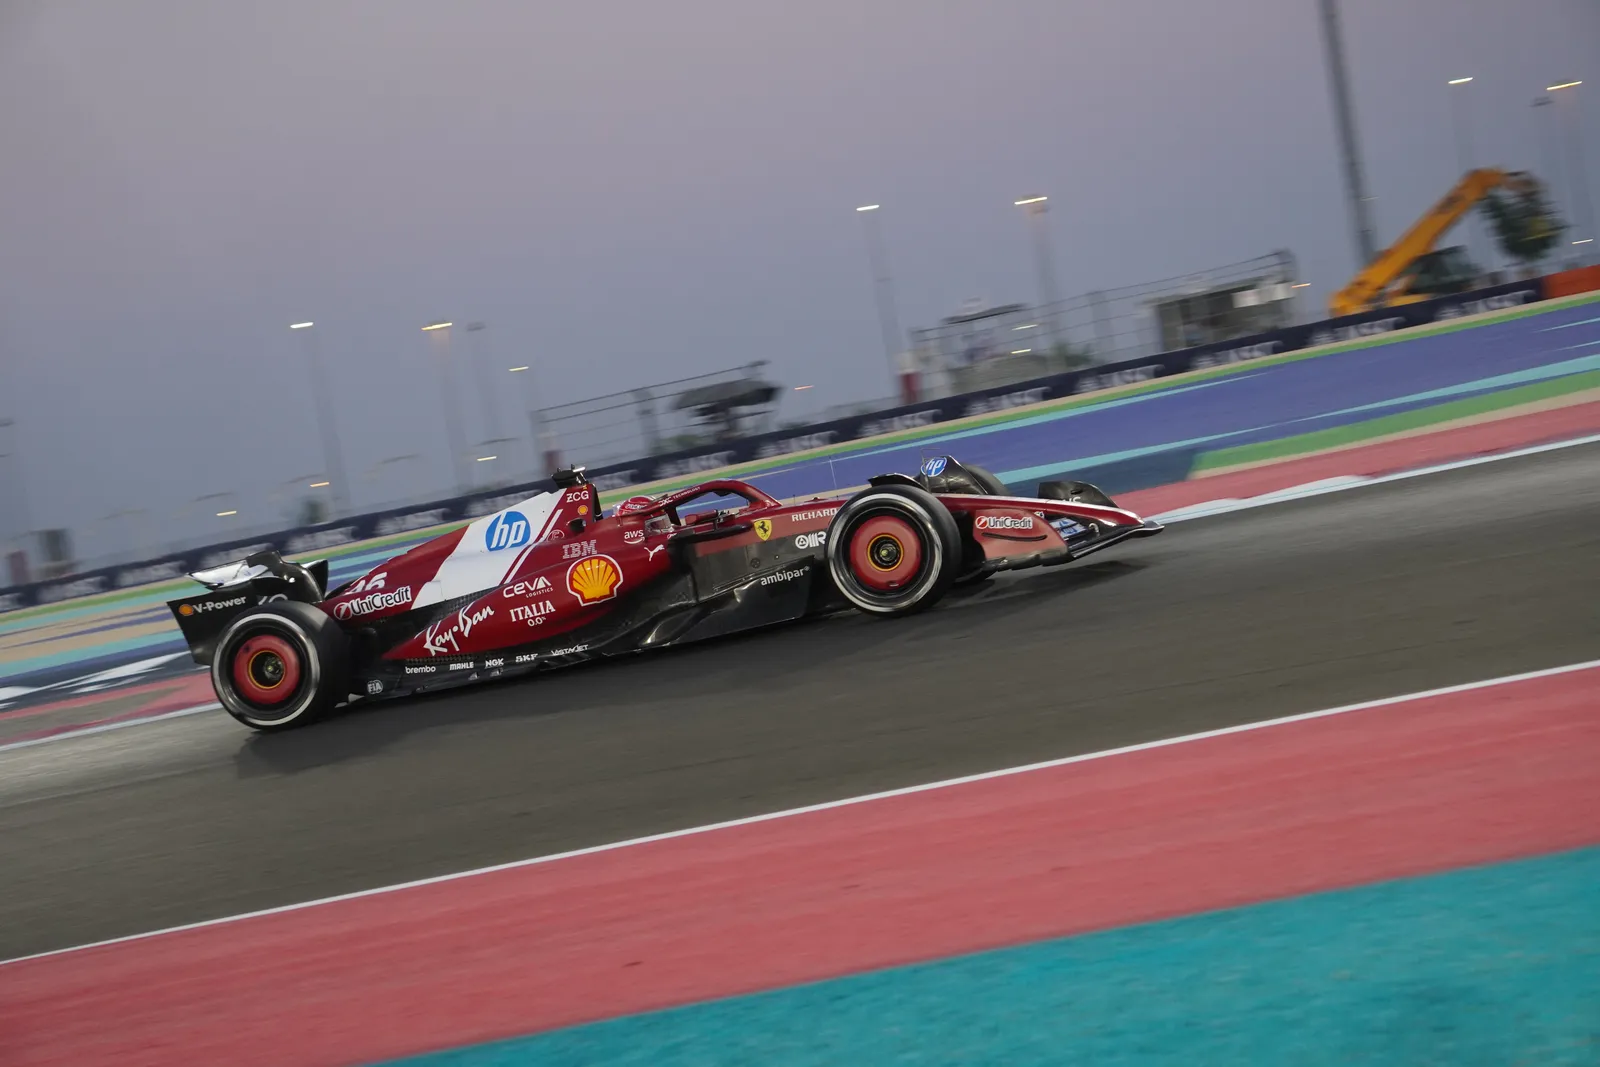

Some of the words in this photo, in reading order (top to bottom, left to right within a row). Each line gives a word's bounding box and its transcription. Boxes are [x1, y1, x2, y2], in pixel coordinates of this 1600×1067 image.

[566, 490, 589, 503] ZCG
[988, 517, 1032, 529] UniCredit
[490, 511, 527, 549] hp
[624, 530, 644, 540] aws
[562, 539, 598, 559] IBM
[760, 568, 804, 586] ambipar
[503, 576, 552, 598] CEVA
[525, 587, 554, 598] LOGISTICS
[193, 596, 247, 614] V-Power
[350, 586, 412, 615] UniCredit
[509, 600, 556, 622] ITALIA
[485, 658, 504, 668] NGK
[515, 653, 538, 663] SKF
[405, 665, 436, 674] brembo
[449, 661, 474, 671] MAHLE
